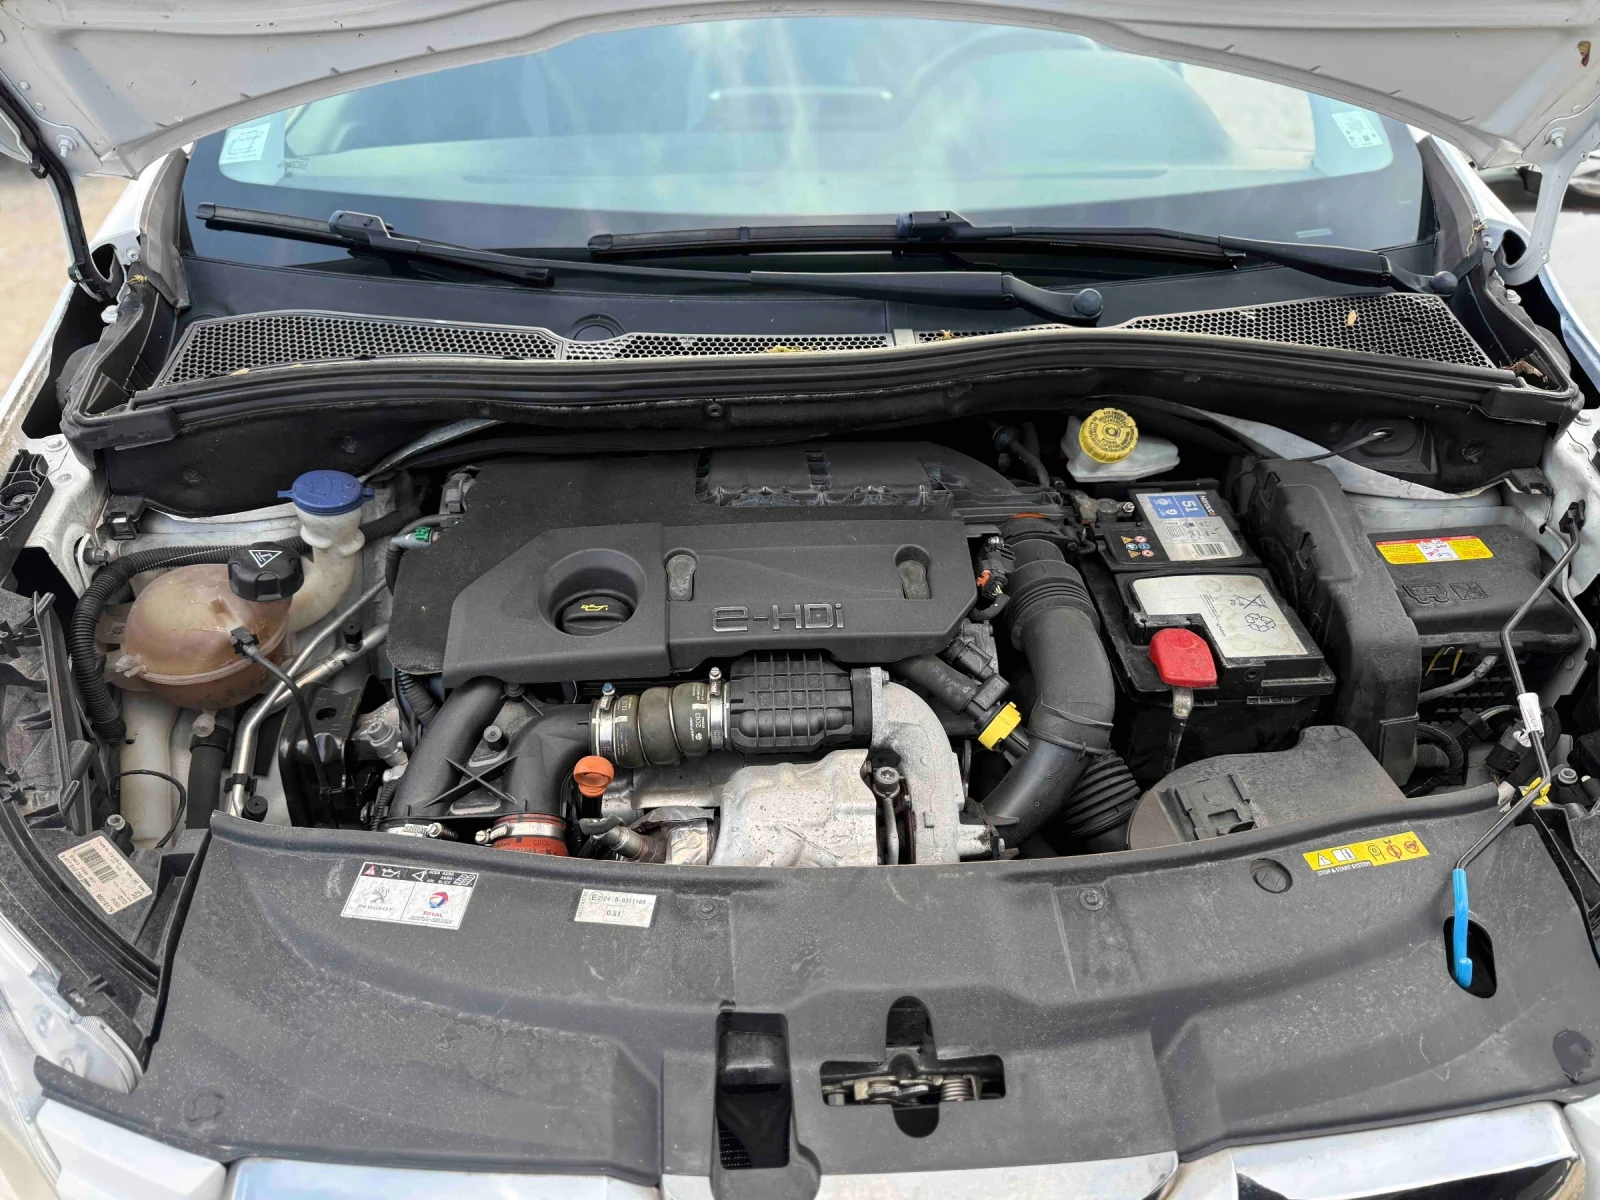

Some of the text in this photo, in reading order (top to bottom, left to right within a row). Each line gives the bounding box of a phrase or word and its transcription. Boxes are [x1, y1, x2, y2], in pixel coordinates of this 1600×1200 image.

[1181, 500, 1199, 512] 51
[711, 603, 844, 632] e-HDi
[1317, 866, 1333, 876] STOP
[1336, 864, 1352, 873] START
[1352, 860, 1372, 870] SYSTEM
[357, 904, 394, 912] PEUGEOT
